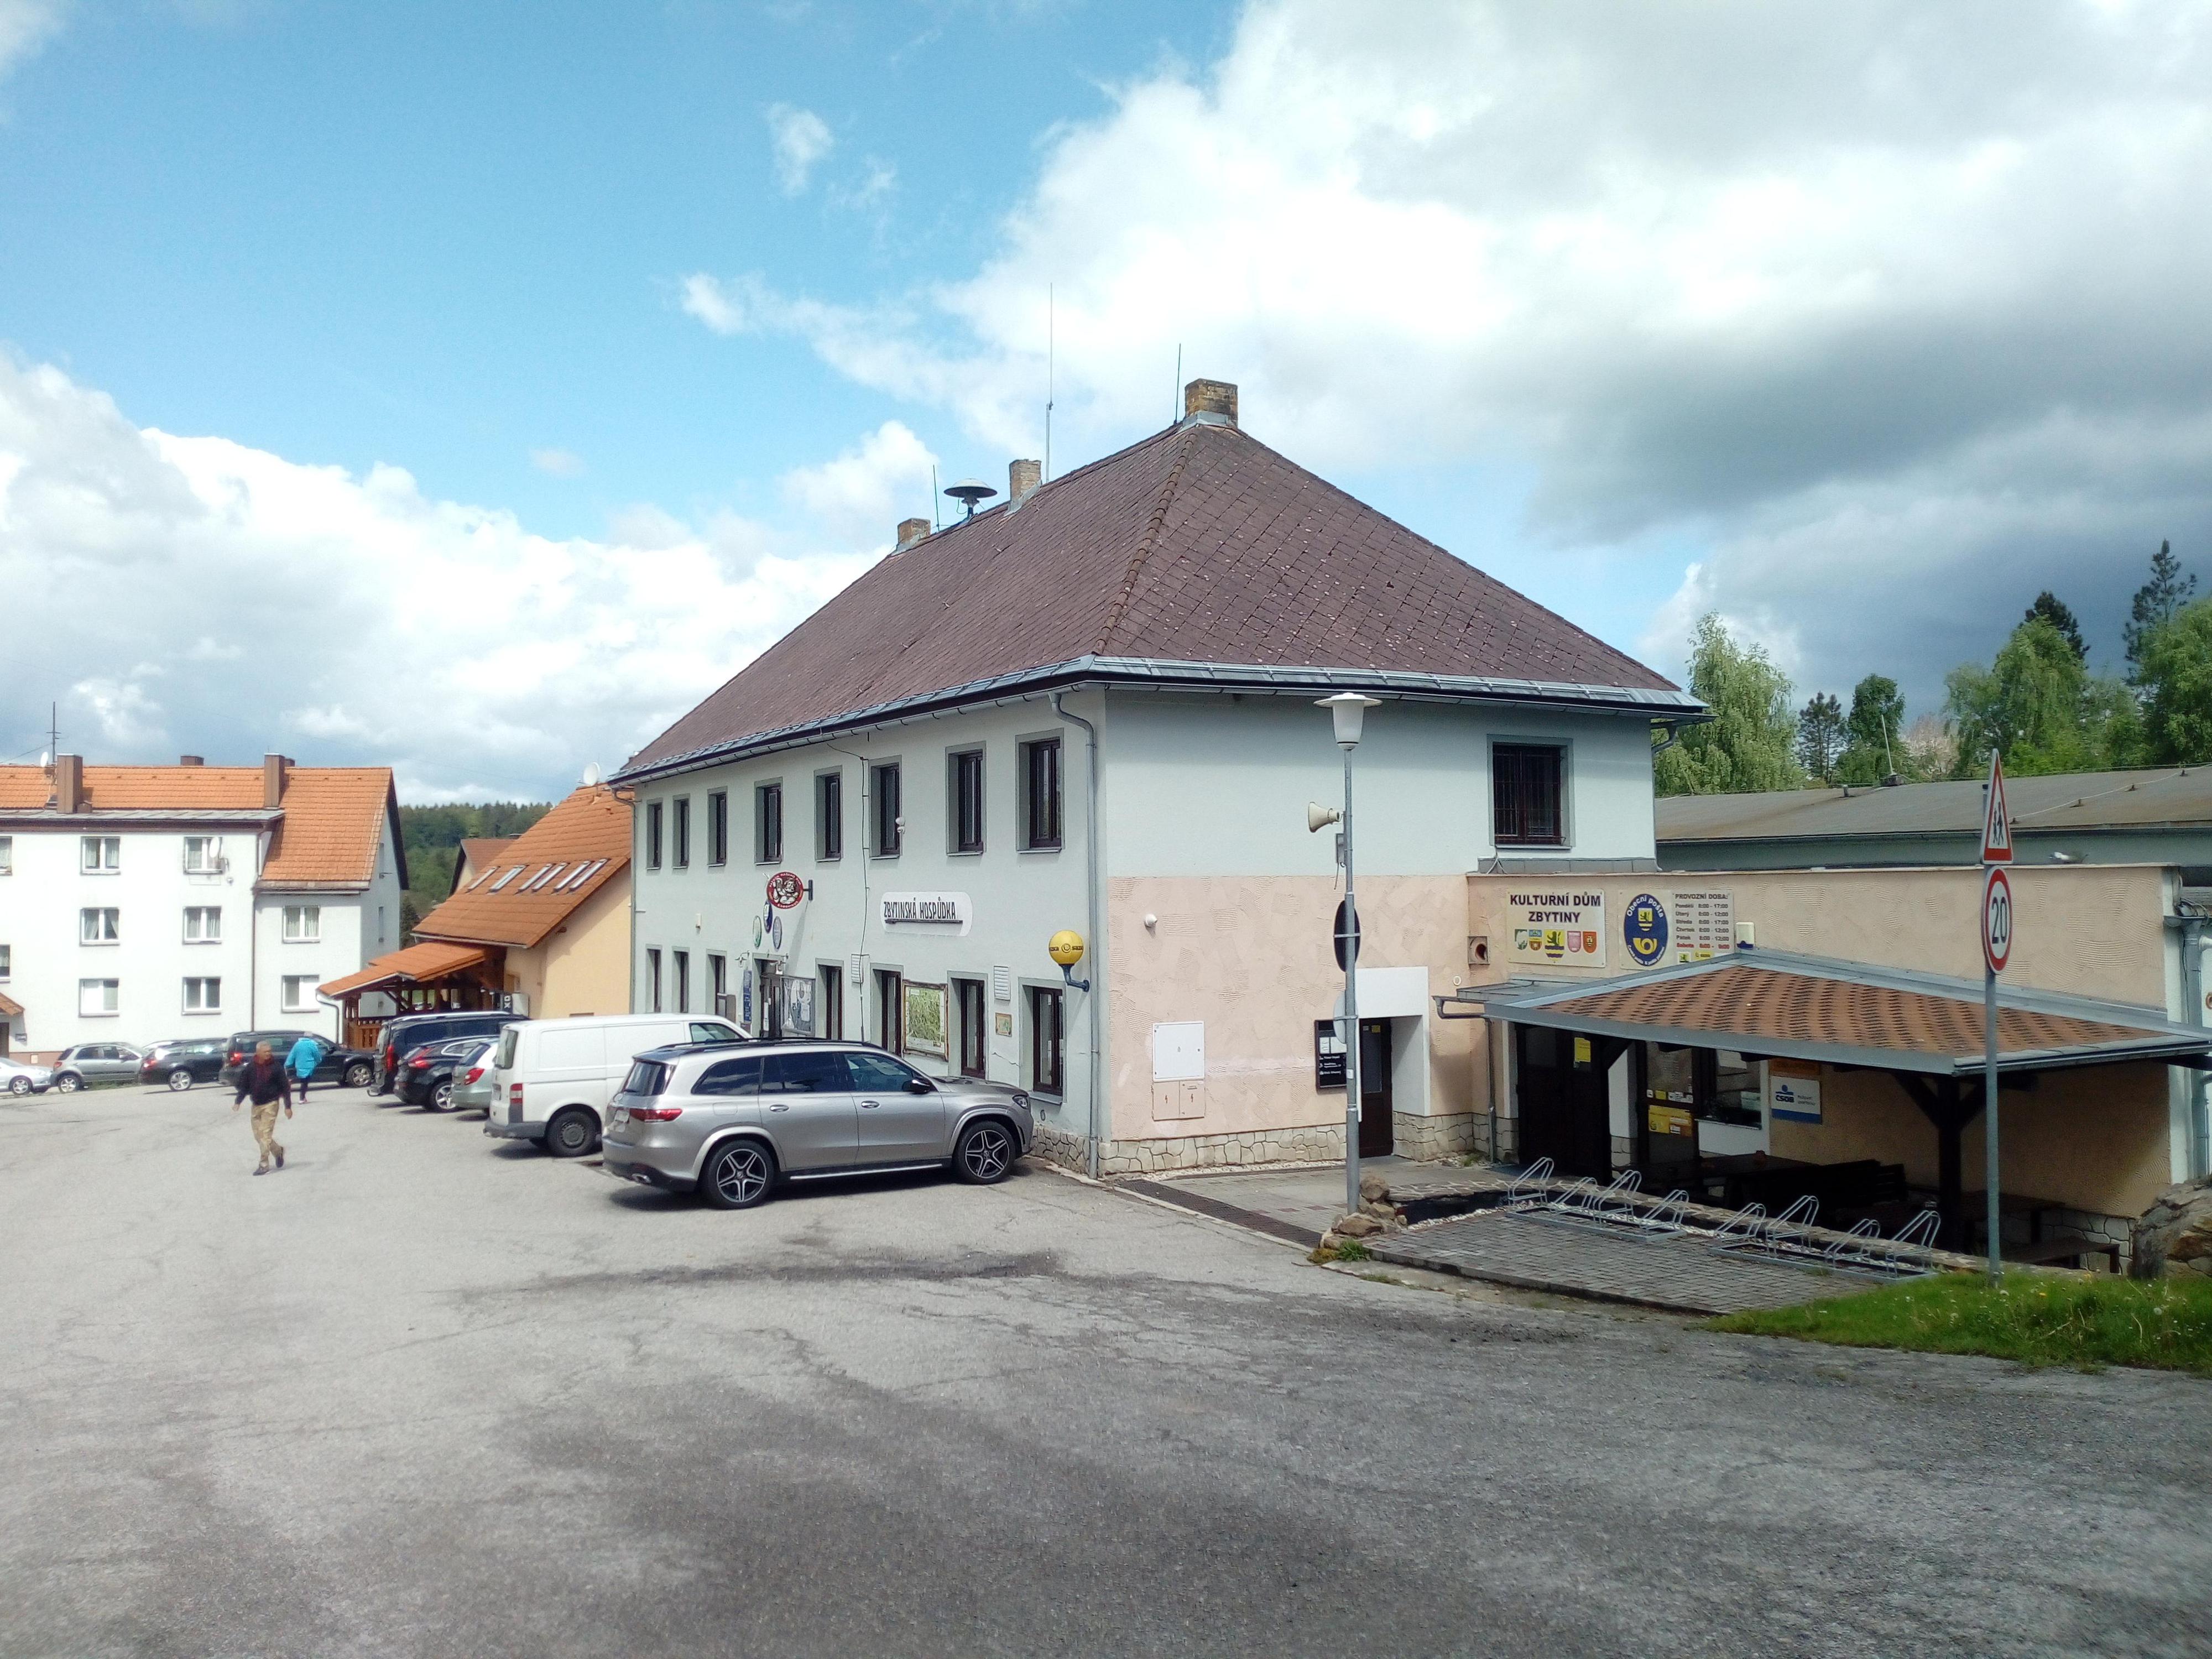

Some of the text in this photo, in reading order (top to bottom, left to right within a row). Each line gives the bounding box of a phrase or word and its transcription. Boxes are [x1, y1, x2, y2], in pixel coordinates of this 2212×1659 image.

[883, 896, 956, 920] ZBYTINSKÁ HOSPŮDKA
[1510, 891, 1601, 907] KULTURNÍ DŮM
[1626, 895, 1664, 918] Obecní pošta
[1528, 911, 1581, 924] ZBYTINY
[1991, 896, 2007, 944] 20
[1775, 1094, 1795, 1103] ČSOB
